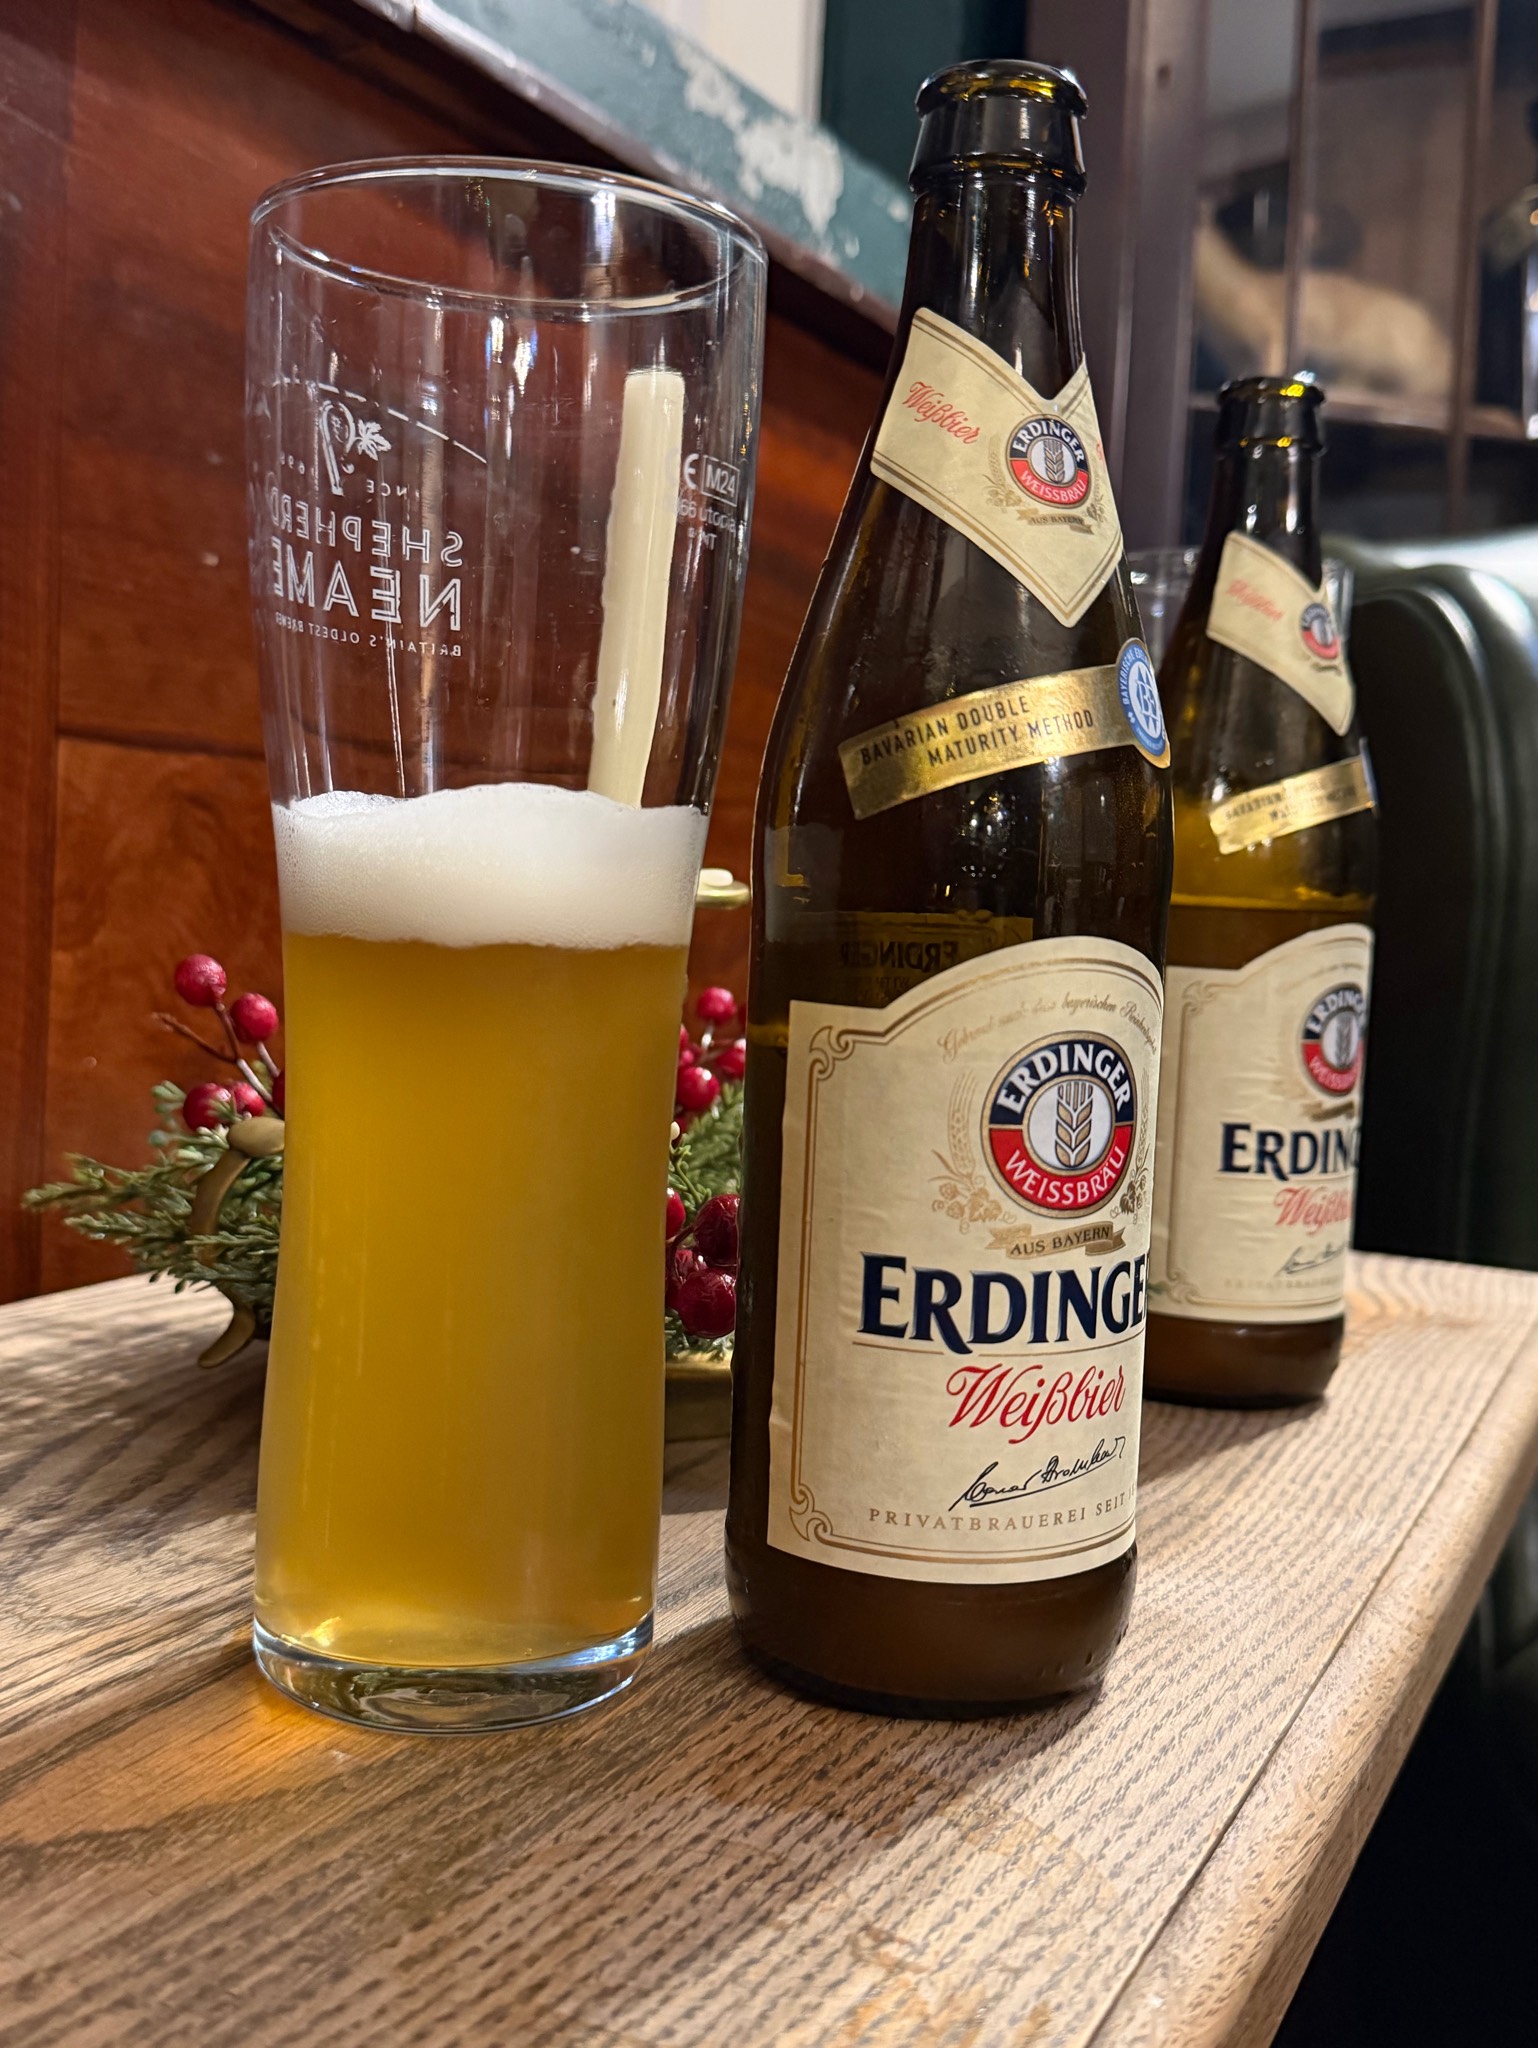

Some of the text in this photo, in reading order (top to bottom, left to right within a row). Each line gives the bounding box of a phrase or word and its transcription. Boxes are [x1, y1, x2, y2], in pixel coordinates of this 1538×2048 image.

[902, 381, 980, 444] Weißbier
[1011, 419, 1085, 463] ERDINGER
[706, 464, 736, 498] M24
[861, 695, 1030, 766] BAVARIAN DOUBLE
[927, 723, 1020, 767] MATURITY
[1027, 709, 1094, 739] METHOD
[997, 1043, 1132, 1114] ERDINGER
[1005, 1145, 1126, 1206] WEISSBRÄU
[1218, 1122, 1359, 1182] ERDIN
[1010, 1226, 1112, 1258] AUS BAYERN
[857, 1250, 1150, 1355] ERDINGE
[945, 1362, 1126, 1445] Weißbier
[868, 1492, 1126, 1532] PRIVATBRAUEREI SEIT
